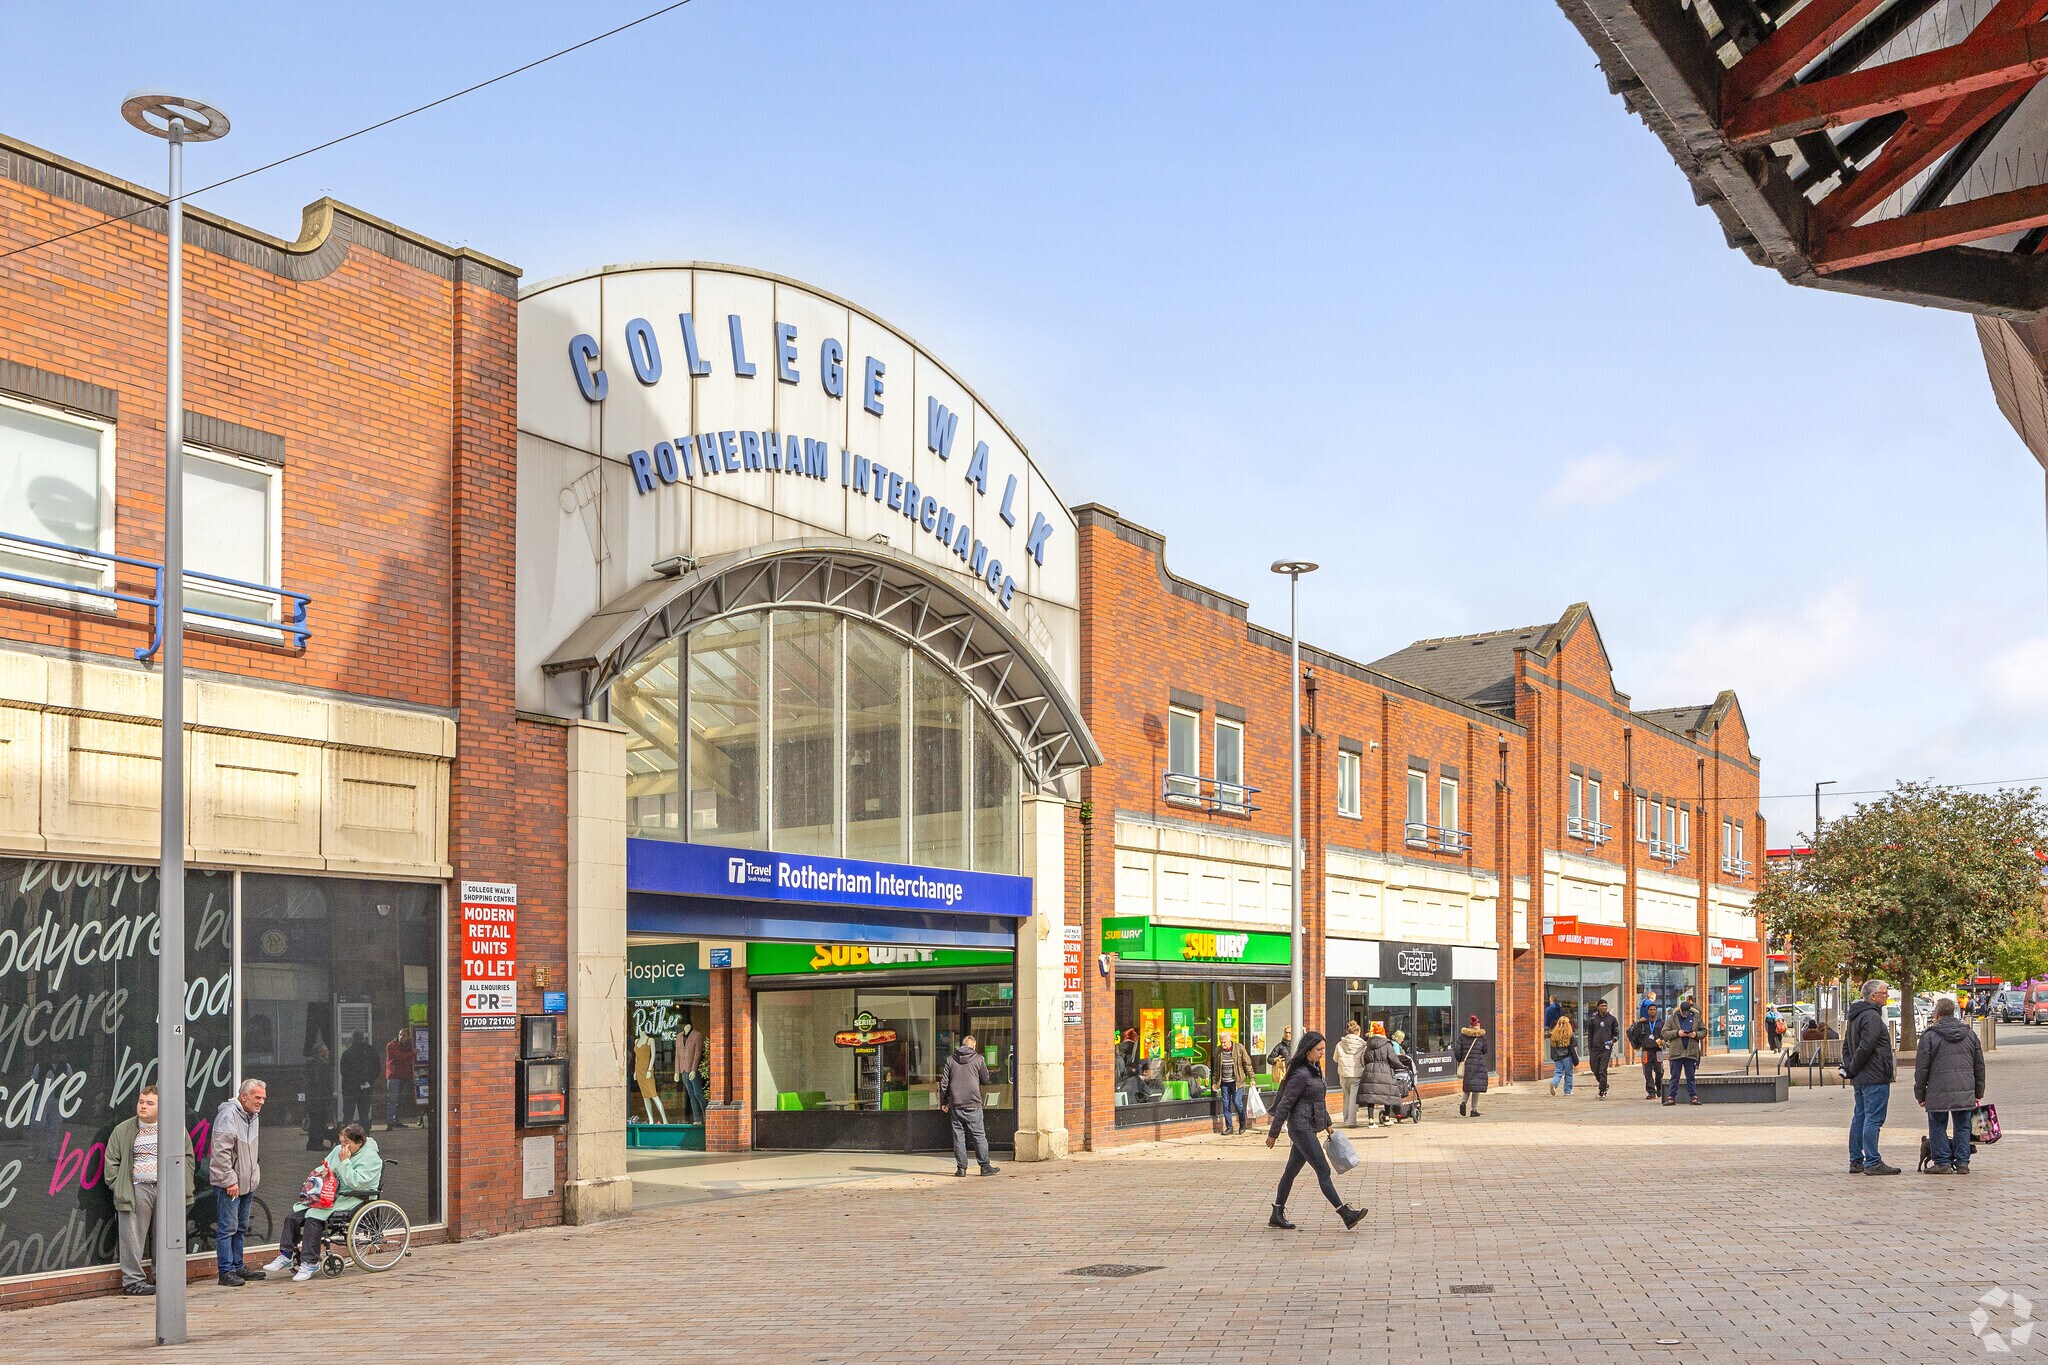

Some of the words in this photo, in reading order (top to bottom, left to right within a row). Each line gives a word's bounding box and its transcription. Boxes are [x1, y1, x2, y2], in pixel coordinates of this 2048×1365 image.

[567, 312, 887, 418] COLLEGE
[926, 395, 1054, 567] WALK
[627, 430, 829, 496] ROTHERHAM
[840, 449, 1018, 611] INTERCHANGE
[746, 862, 772, 877] Travel
[468, 885, 494, 894] COLLEGE
[494, 887, 511, 895] WALK
[778, 862, 872, 894] Rotherham
[875, 871, 963, 905] Interchange
[463, 893, 493, 902] SHOPPING
[493, 895, 515, 903] CENTRE
[464, 906, 515, 922] MODERN
[468, 924, 511, 939] RETAIL
[1104, 929, 1143, 940] SUBWAY
[472, 941, 508, 955] UNITS
[1184, 933, 1249, 959] SUBWAY
[1565, 935, 1582, 944] BRANDS
[1583, 936, 1600, 946] BOTTOM
[1600, 937, 1614, 947] PRICES
[809, 944, 936, 970] SUBWAY
[1064, 953, 1079, 964] ETAIL
[1723, 943, 1744, 962] bargains
[464, 959, 485, 977] TO
[487, 960, 515, 977] LET
[1397, 952, 1438, 972] Creative
[1068, 977, 1081, 989] LET
[465, 993, 500, 1010] CPR
[1063, 1000, 1075, 1011] PR
[463, 1017, 487, 1026] 01709
[488, 1016, 516, 1026] 721706
[854, 1018, 877, 1027] SERIES
[174, 1025, 182, 1034] 4
